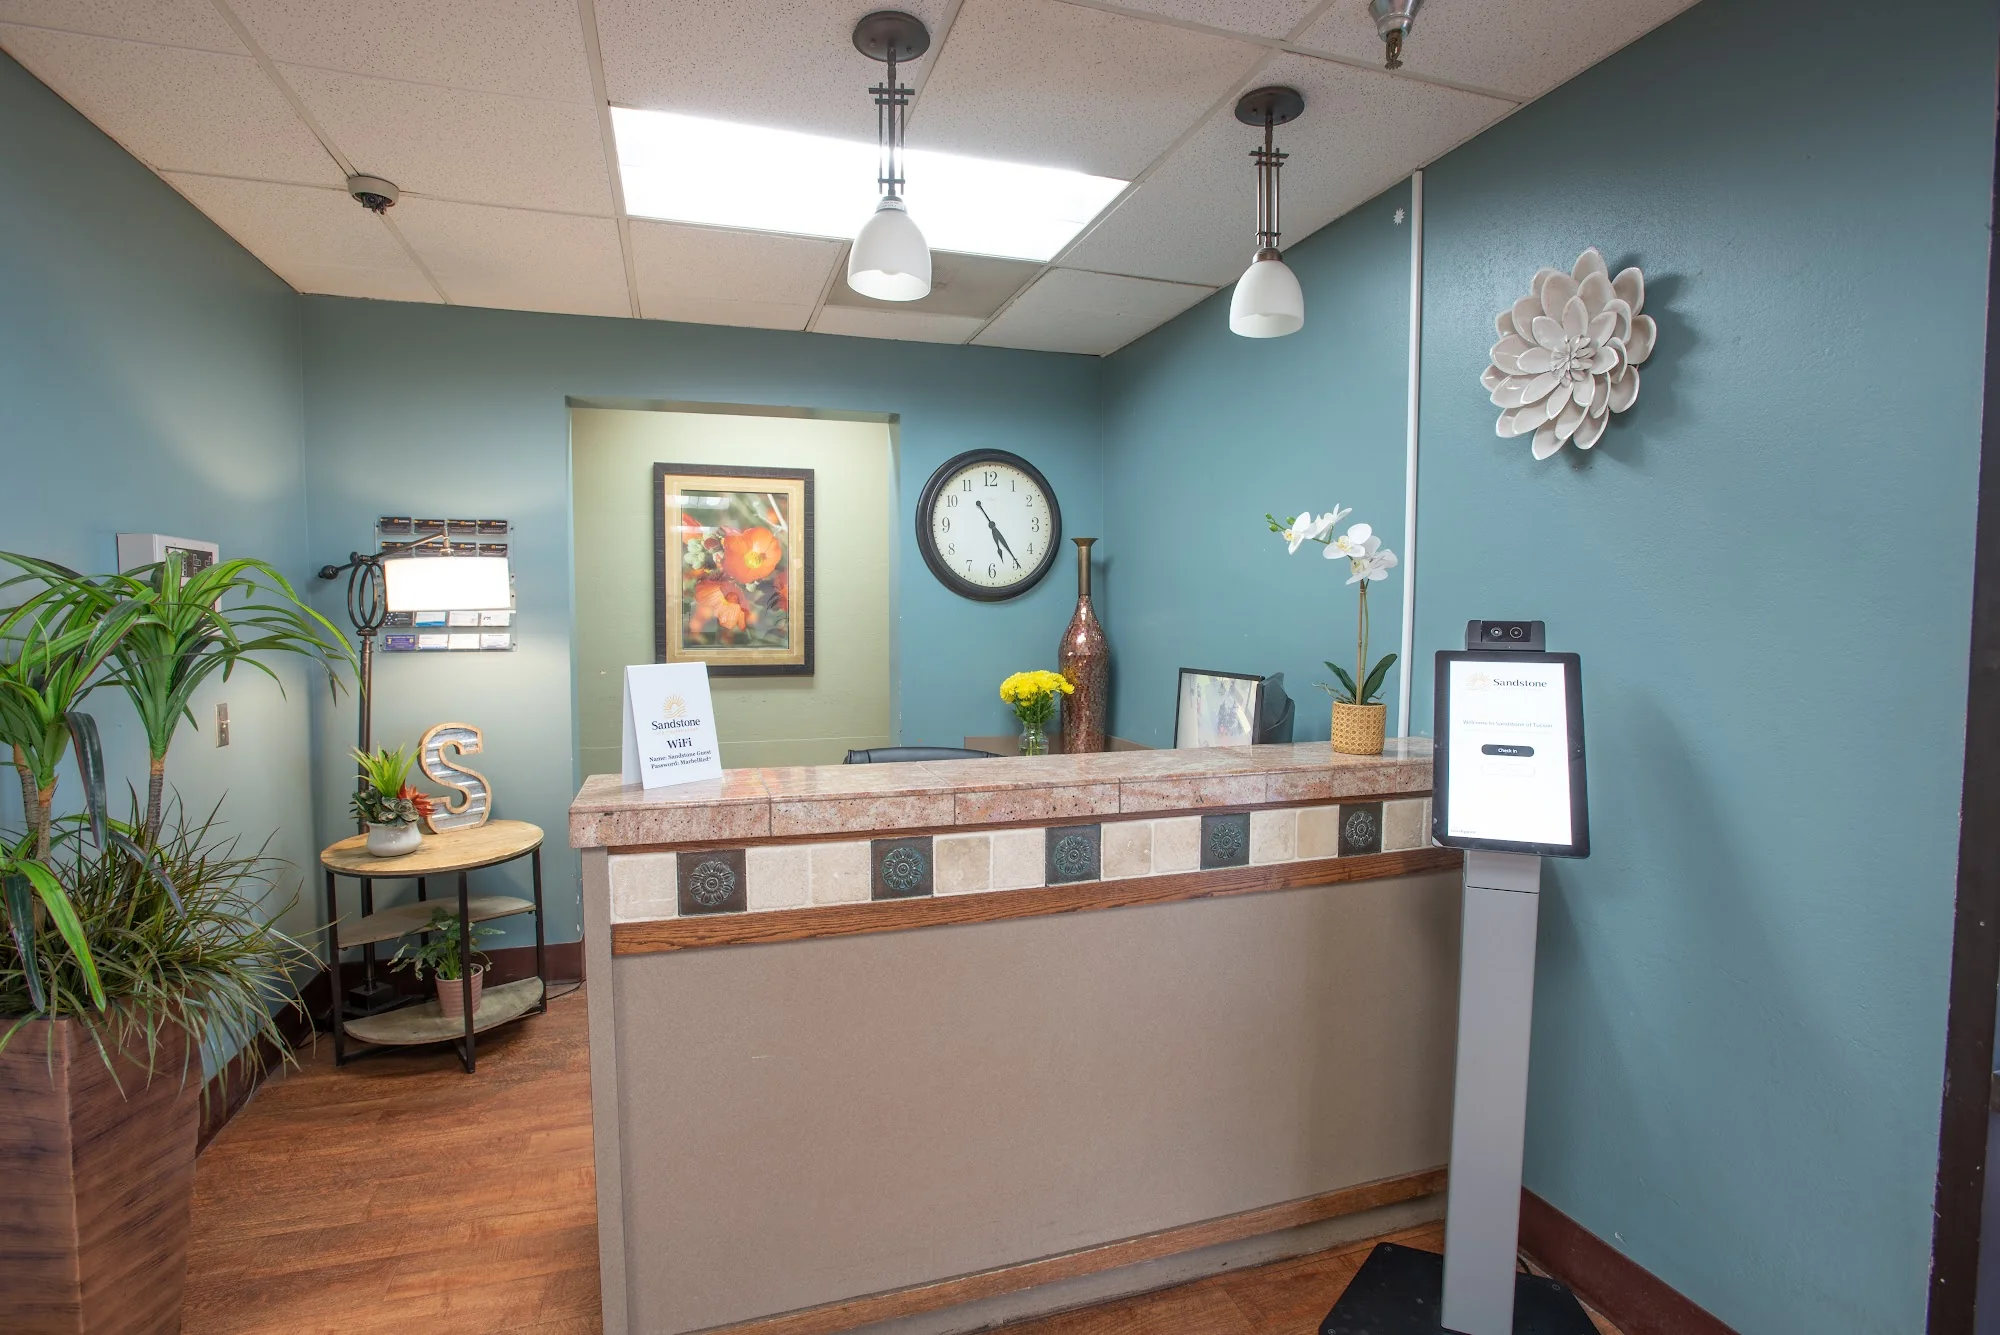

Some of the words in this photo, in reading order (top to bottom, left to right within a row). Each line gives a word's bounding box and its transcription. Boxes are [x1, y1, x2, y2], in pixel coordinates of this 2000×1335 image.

[983, 471, 998, 487] 12
[962, 480, 972, 492] 11
[1011, 480, 1016, 492] 1
[946, 495, 958, 508] 10
[1026, 495, 1033, 507] 2
[942, 517, 951, 533] 9
[1032, 517, 1039, 532] 3
[948, 543, 956, 555] 8
[1027, 543, 1033, 554] 4
[966, 560, 973, 572] 7
[1012, 558, 1020, 570] 5
[988, 563, 997, 579] 6
[1493, 678, 1547, 688] Sandstone
[652, 719, 700, 730] Sandstone
[667, 737, 692, 749] WiFi
[417, 722, 492, 834] S
